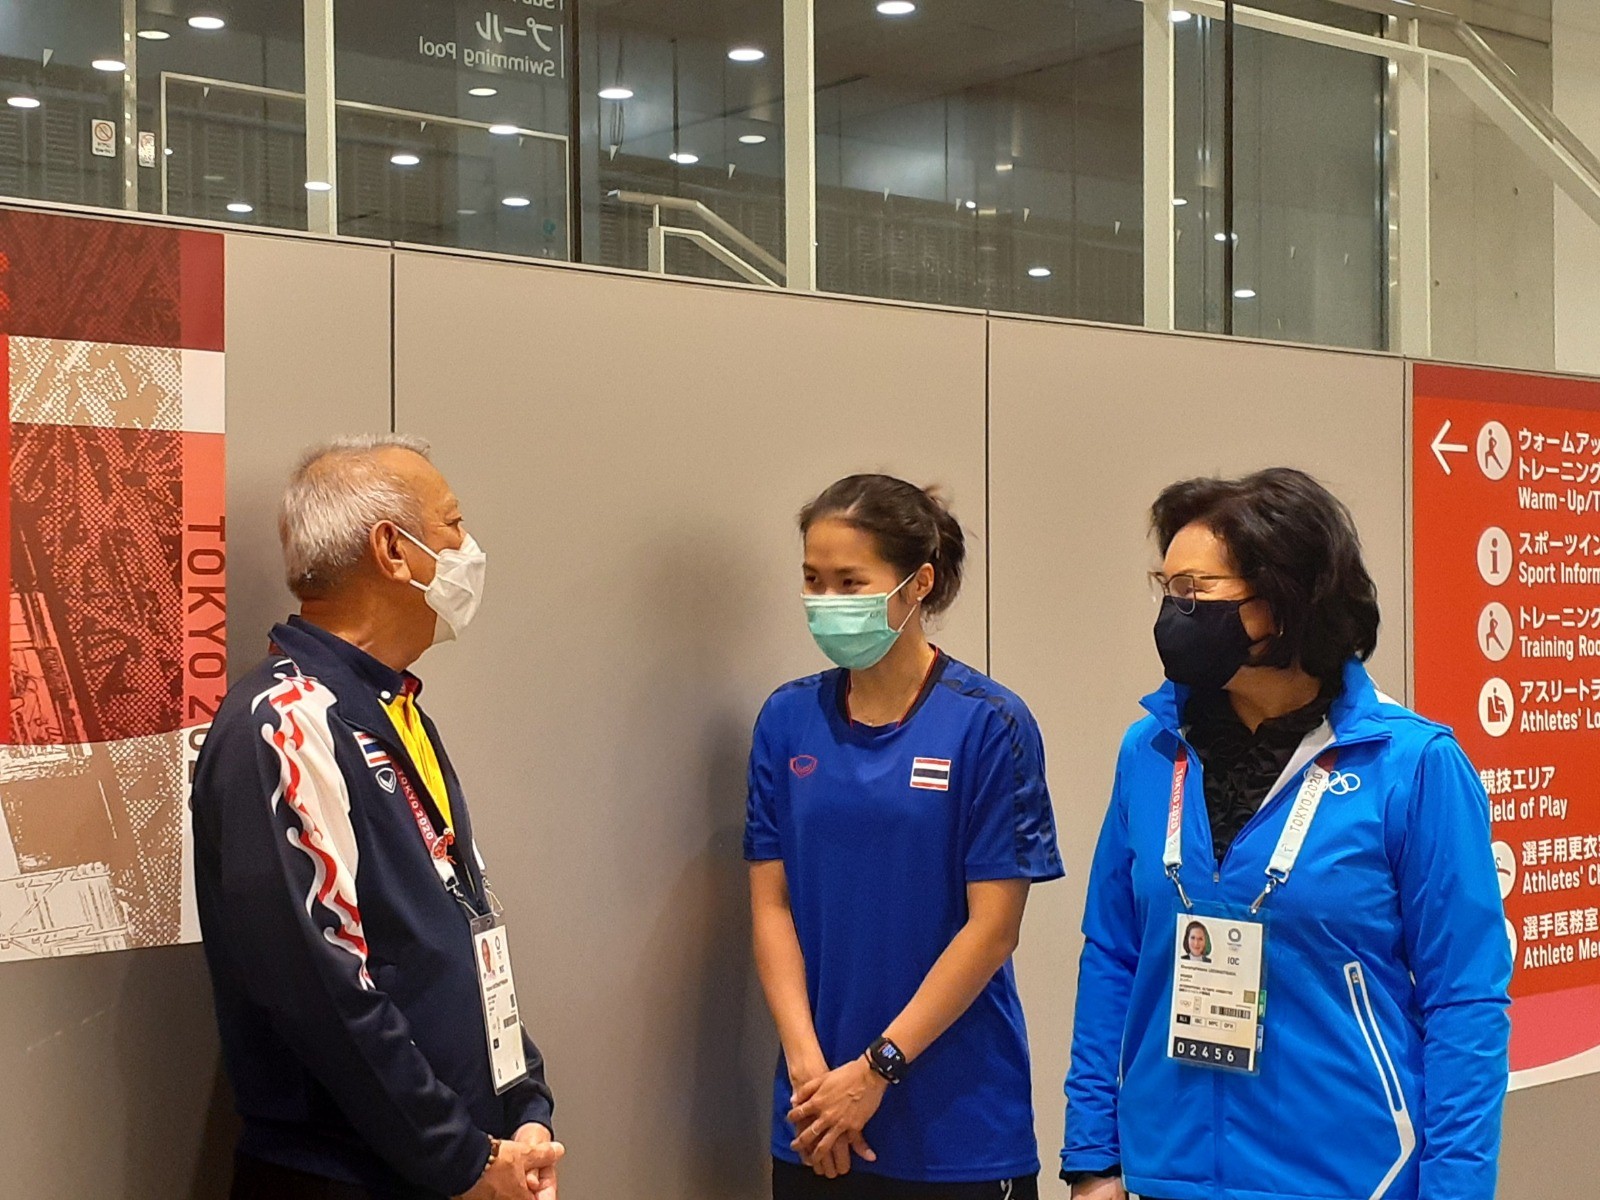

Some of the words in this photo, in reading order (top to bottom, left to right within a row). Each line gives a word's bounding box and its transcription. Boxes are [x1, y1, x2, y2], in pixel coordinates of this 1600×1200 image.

[1519, 562, 1556, 587] Sport
[187, 515, 226, 680] TOKYO
[1519, 633, 1574, 661] Training
[1520, 707, 1582, 732] Athletes'
[1480, 766, 1555, 795] 競技エリア
[1290, 798, 1312, 831] TOKYO
[1520, 796, 1535, 820] of
[1539, 795, 1568, 820] Play
[415, 809, 434, 840] 2020
[1522, 834, 1600, 866] 選手用更衣
[1522, 866, 1583, 894] Athletes'
[1523, 906, 1599, 942] 選手医務室
[1523, 942, 1574, 970] Athlete
[1578, 937, 1600, 961] Me
